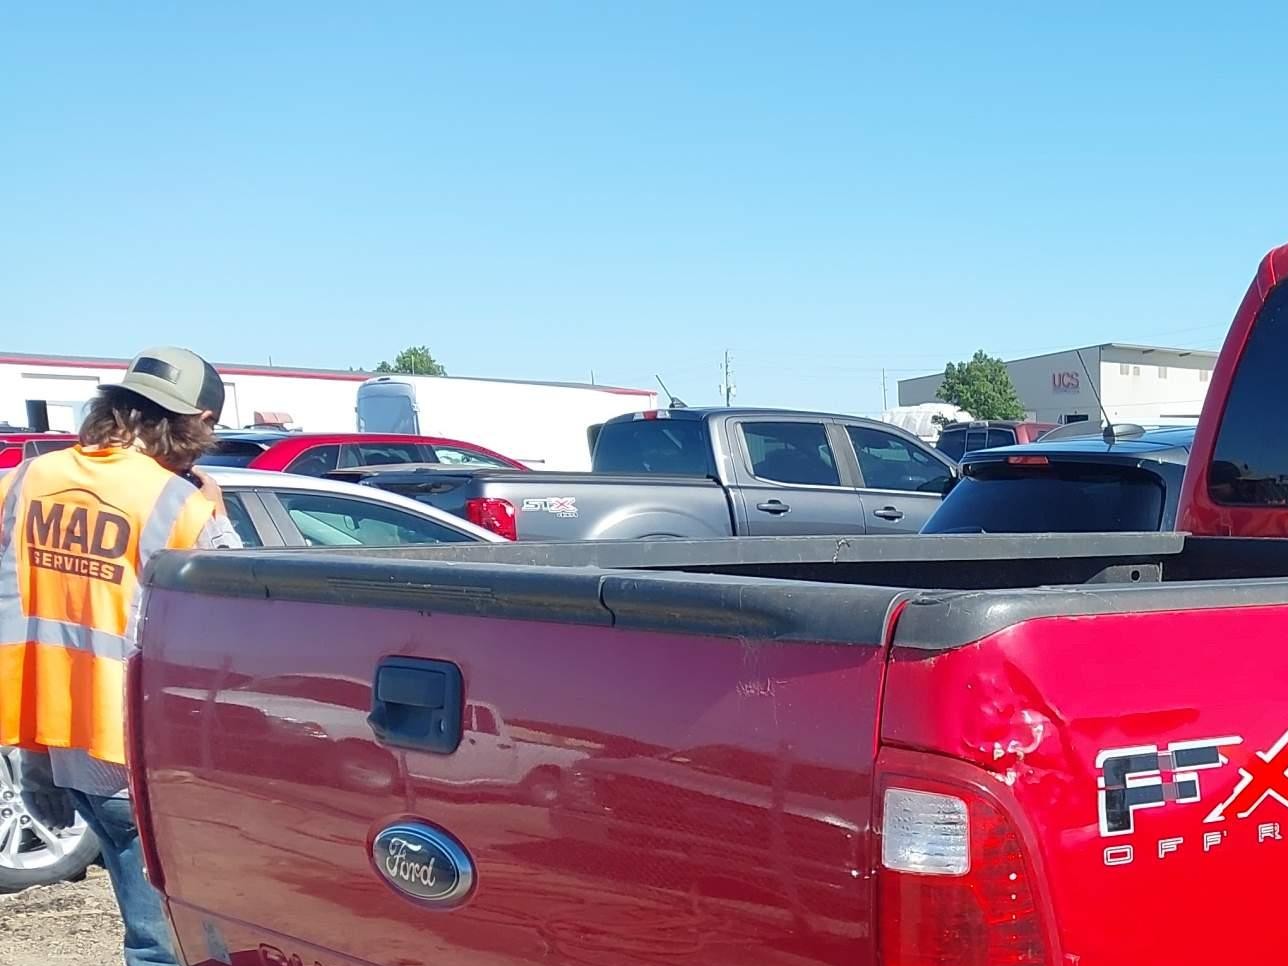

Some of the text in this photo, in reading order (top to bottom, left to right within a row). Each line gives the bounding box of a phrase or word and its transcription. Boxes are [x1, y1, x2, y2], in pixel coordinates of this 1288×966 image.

[1052, 371, 1080, 389] UCS
[522, 496, 579, 513] STX
[26, 499, 131, 559] MAD
[33, 550, 115, 580] SERVICES
[385, 837, 436, 887] Ford
[1103, 830, 1227, 867] OFF
